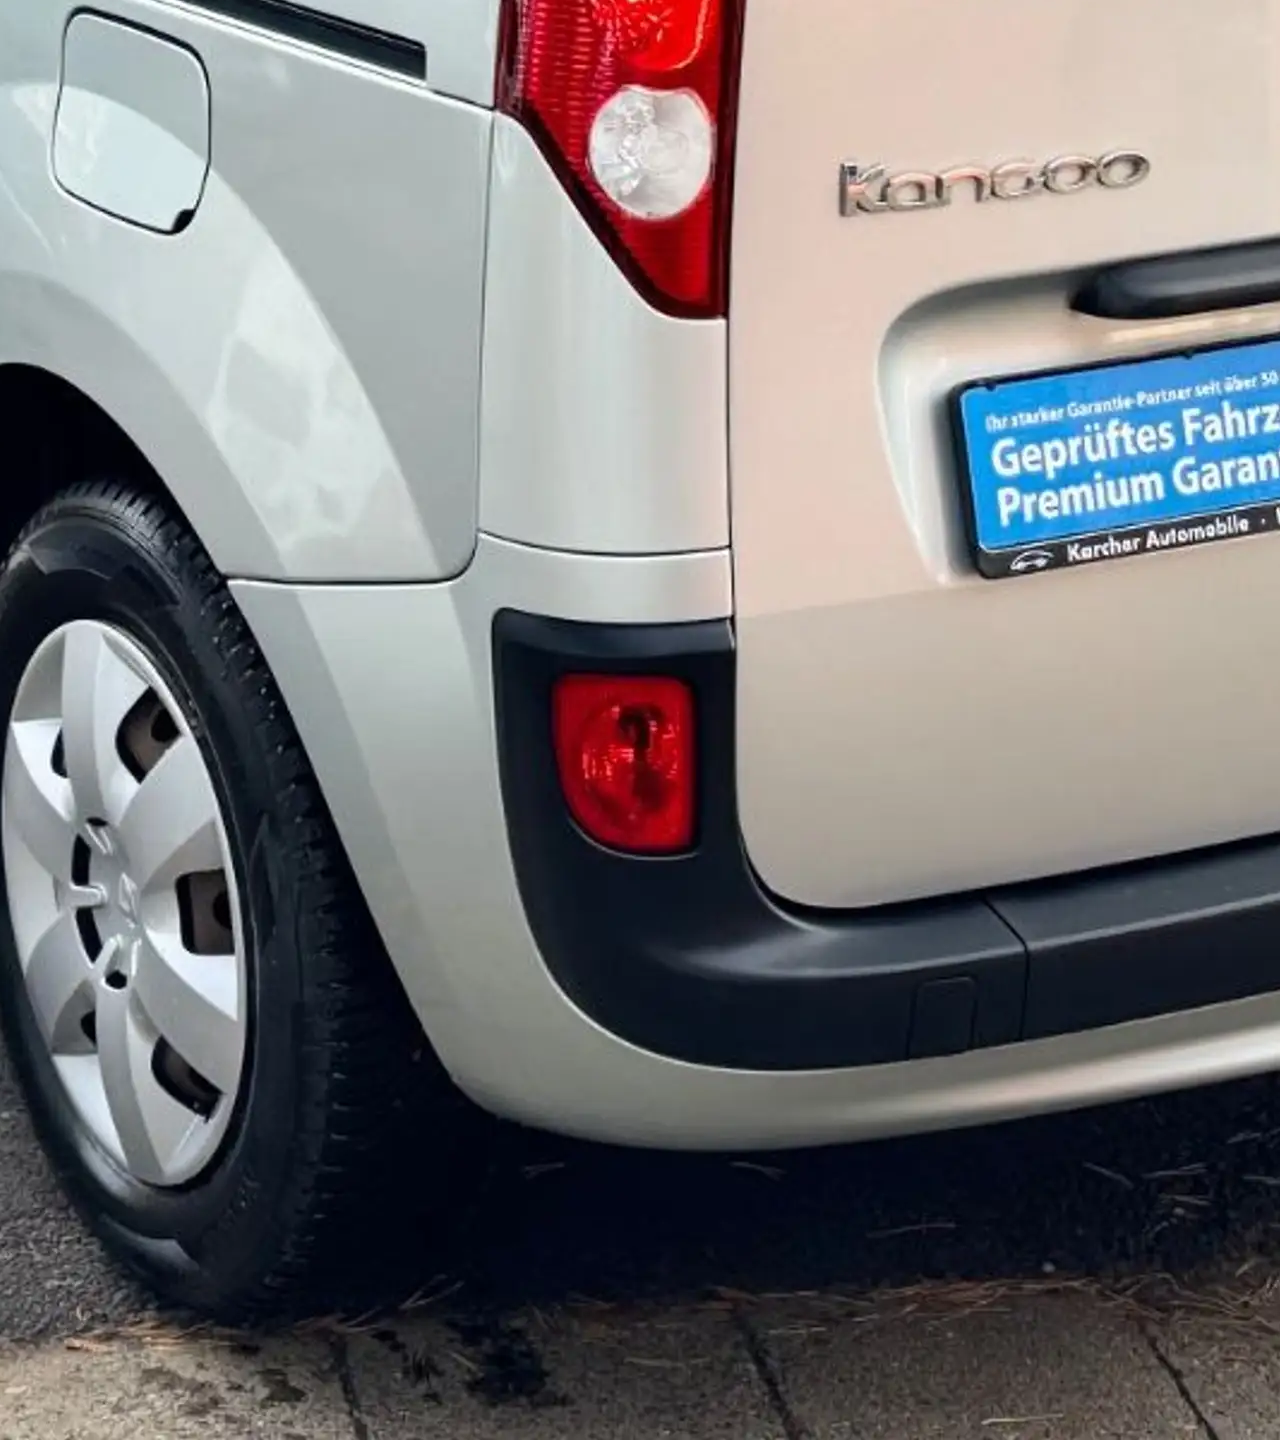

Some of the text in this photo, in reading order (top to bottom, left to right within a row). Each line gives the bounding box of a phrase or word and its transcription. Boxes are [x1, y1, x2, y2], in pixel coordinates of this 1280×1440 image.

[985, 412, 1008, 433] Ihr
[1011, 406, 1065, 427] starker
[1067, 385, 1192, 419] Garantie-Partner
[1195, 378, 1222, 399] seit
[1224, 375, 1258, 394] über
[991, 417, 1177, 480] Geprüftes
[996, 471, 1166, 528] Premium
[1146, 517, 1251, 550] Automobile
